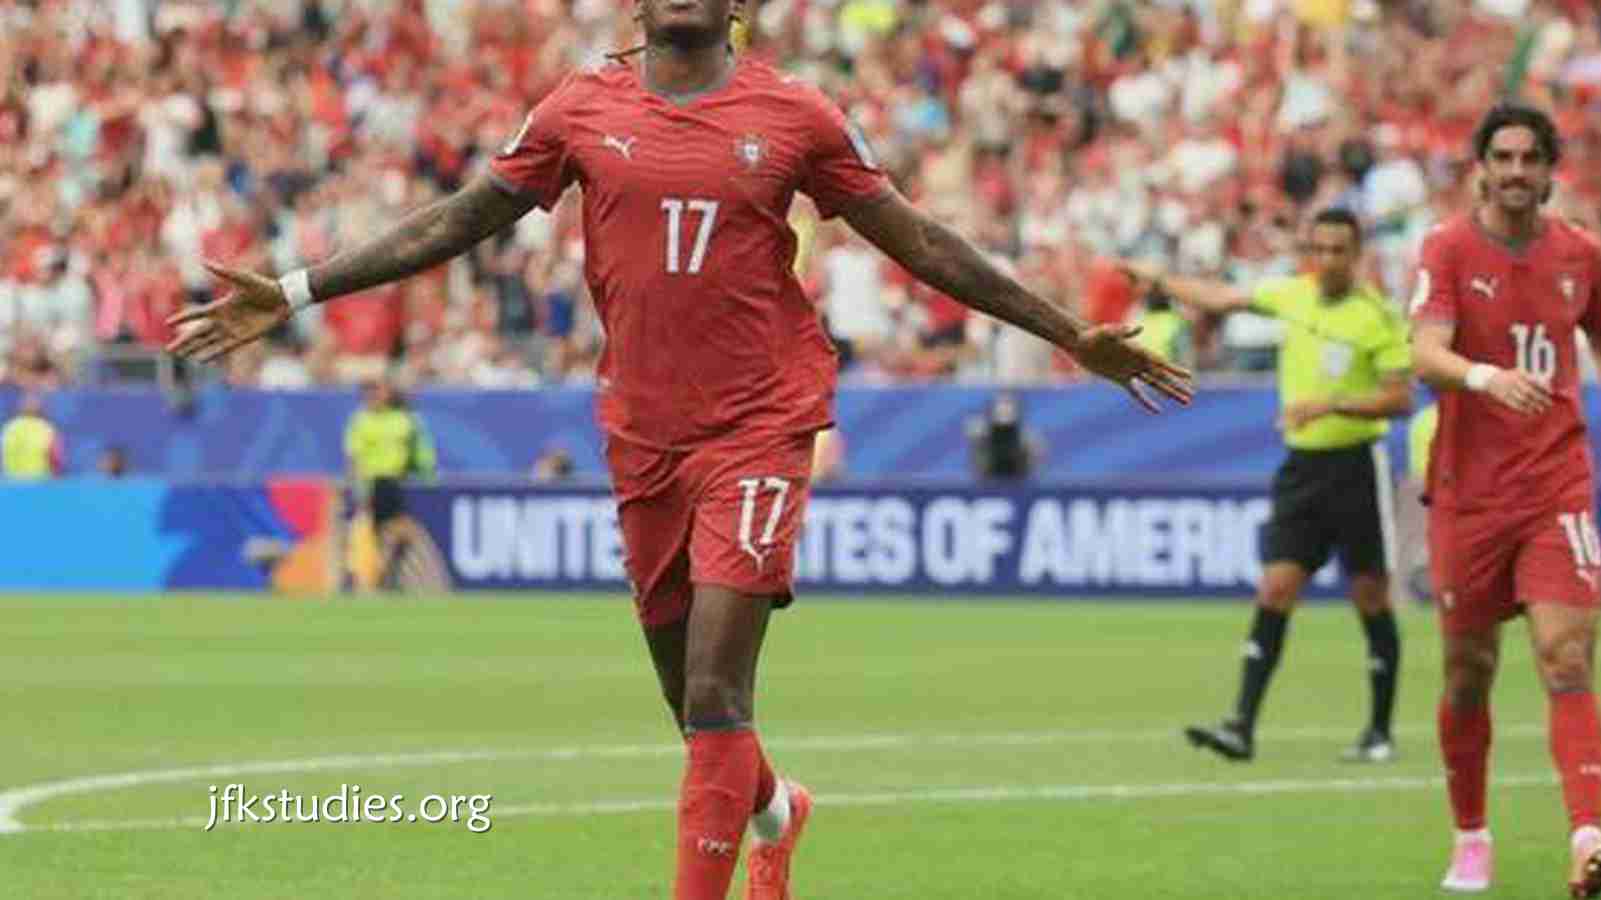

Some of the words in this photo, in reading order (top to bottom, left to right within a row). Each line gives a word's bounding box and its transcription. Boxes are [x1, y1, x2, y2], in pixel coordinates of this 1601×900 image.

[660, 198, 719, 273] 17
[1508, 323, 1556, 387] 16
[451, 496, 626, 579] UNITE
[793, 497, 916, 583] TES
[922, 496, 1014, 583] OF
[1018, 497, 1339, 586] AMERIC
[737, 477, 790, 549] 17
